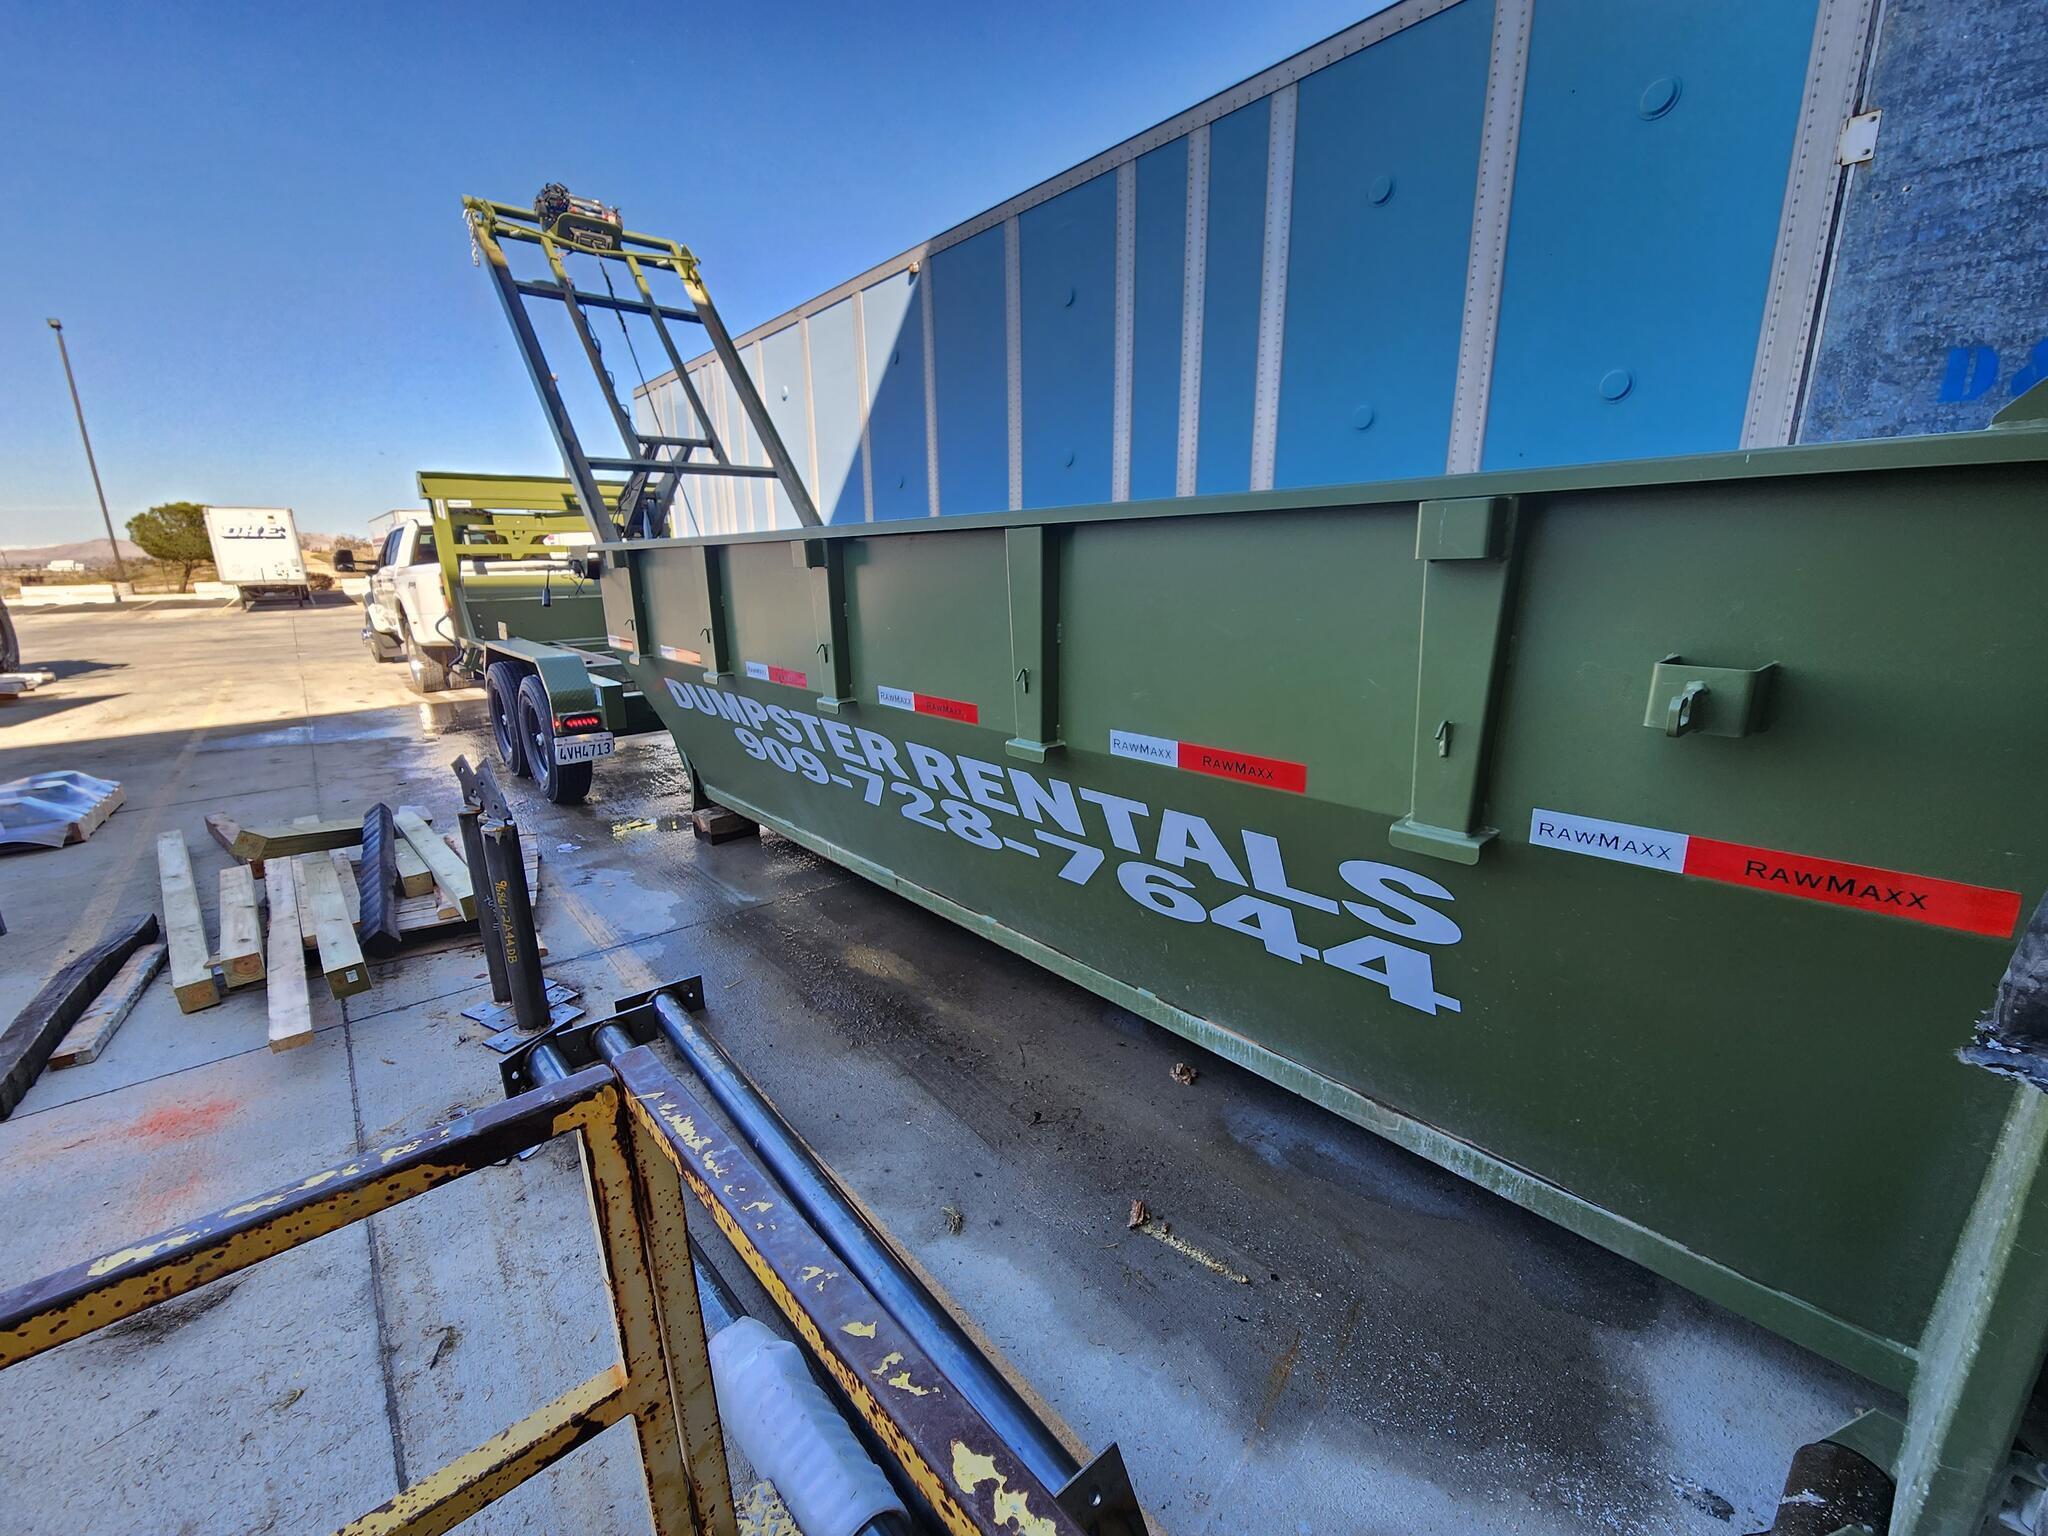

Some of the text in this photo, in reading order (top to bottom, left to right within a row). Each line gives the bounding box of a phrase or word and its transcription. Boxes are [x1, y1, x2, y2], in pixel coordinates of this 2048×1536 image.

[560, 742, 611, 760] 4VH4713
[664, 677, 1463, 945] DUMPSTER RENTALS
[734, 727, 1462, 1016] 909-728-7644
